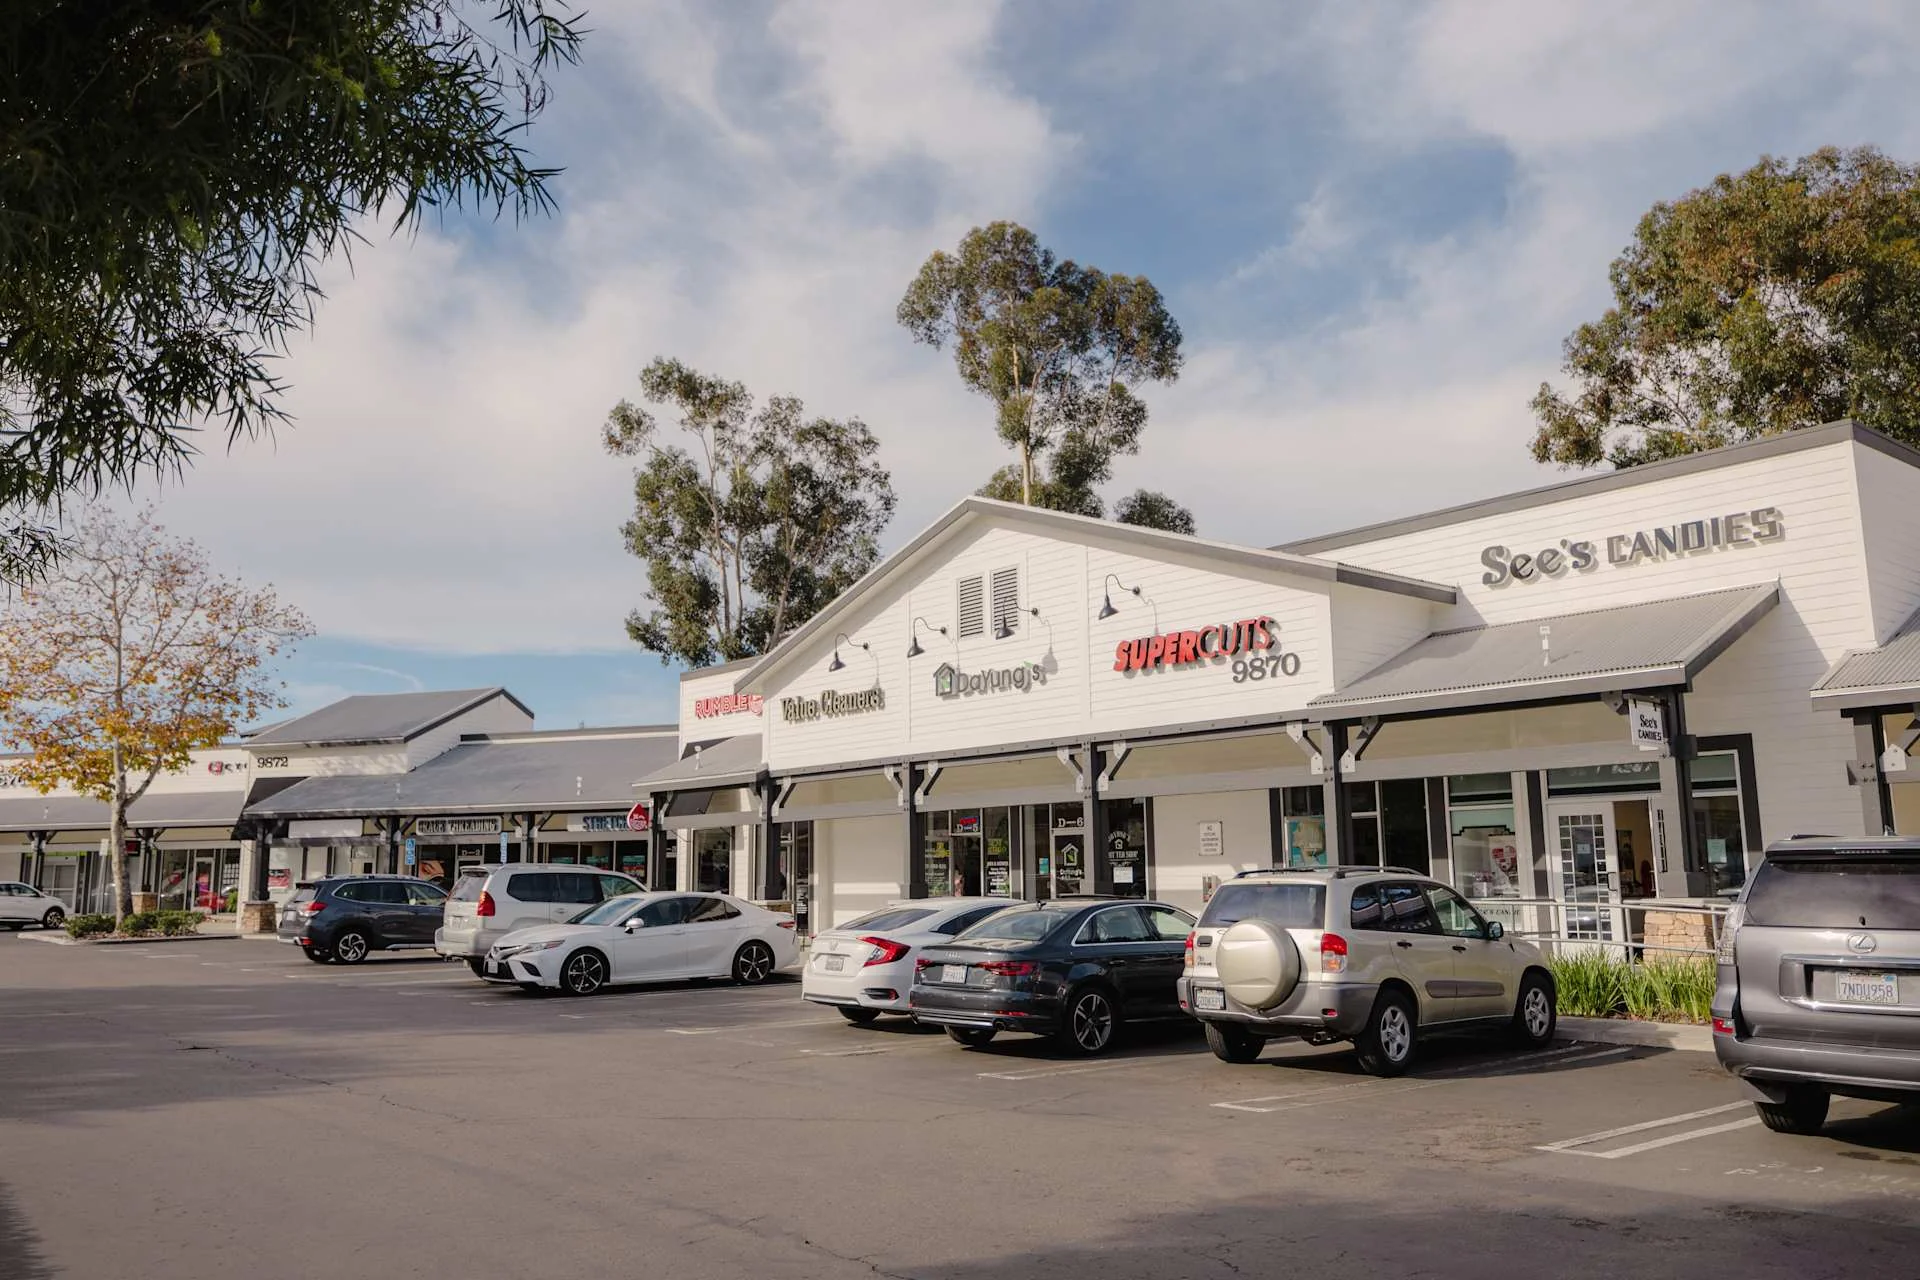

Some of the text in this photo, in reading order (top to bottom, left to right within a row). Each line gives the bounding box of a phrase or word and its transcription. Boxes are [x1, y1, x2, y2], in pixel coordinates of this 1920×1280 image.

[1480, 506, 1782, 587] See's CANDIES
[1113, 615, 1276, 672] SUPERCUTS
[1231, 651, 1301, 684] 9870
[695, 694, 750, 718] RUMBLE
[780, 688, 883, 721] Value Cleaners
[1637, 714, 1662, 741] See's CANDIES
[257, 756, 289, 769] 9872
[1057, 817, 1084, 828] D-6
[1840, 982, 1894, 998] 7NDU958
